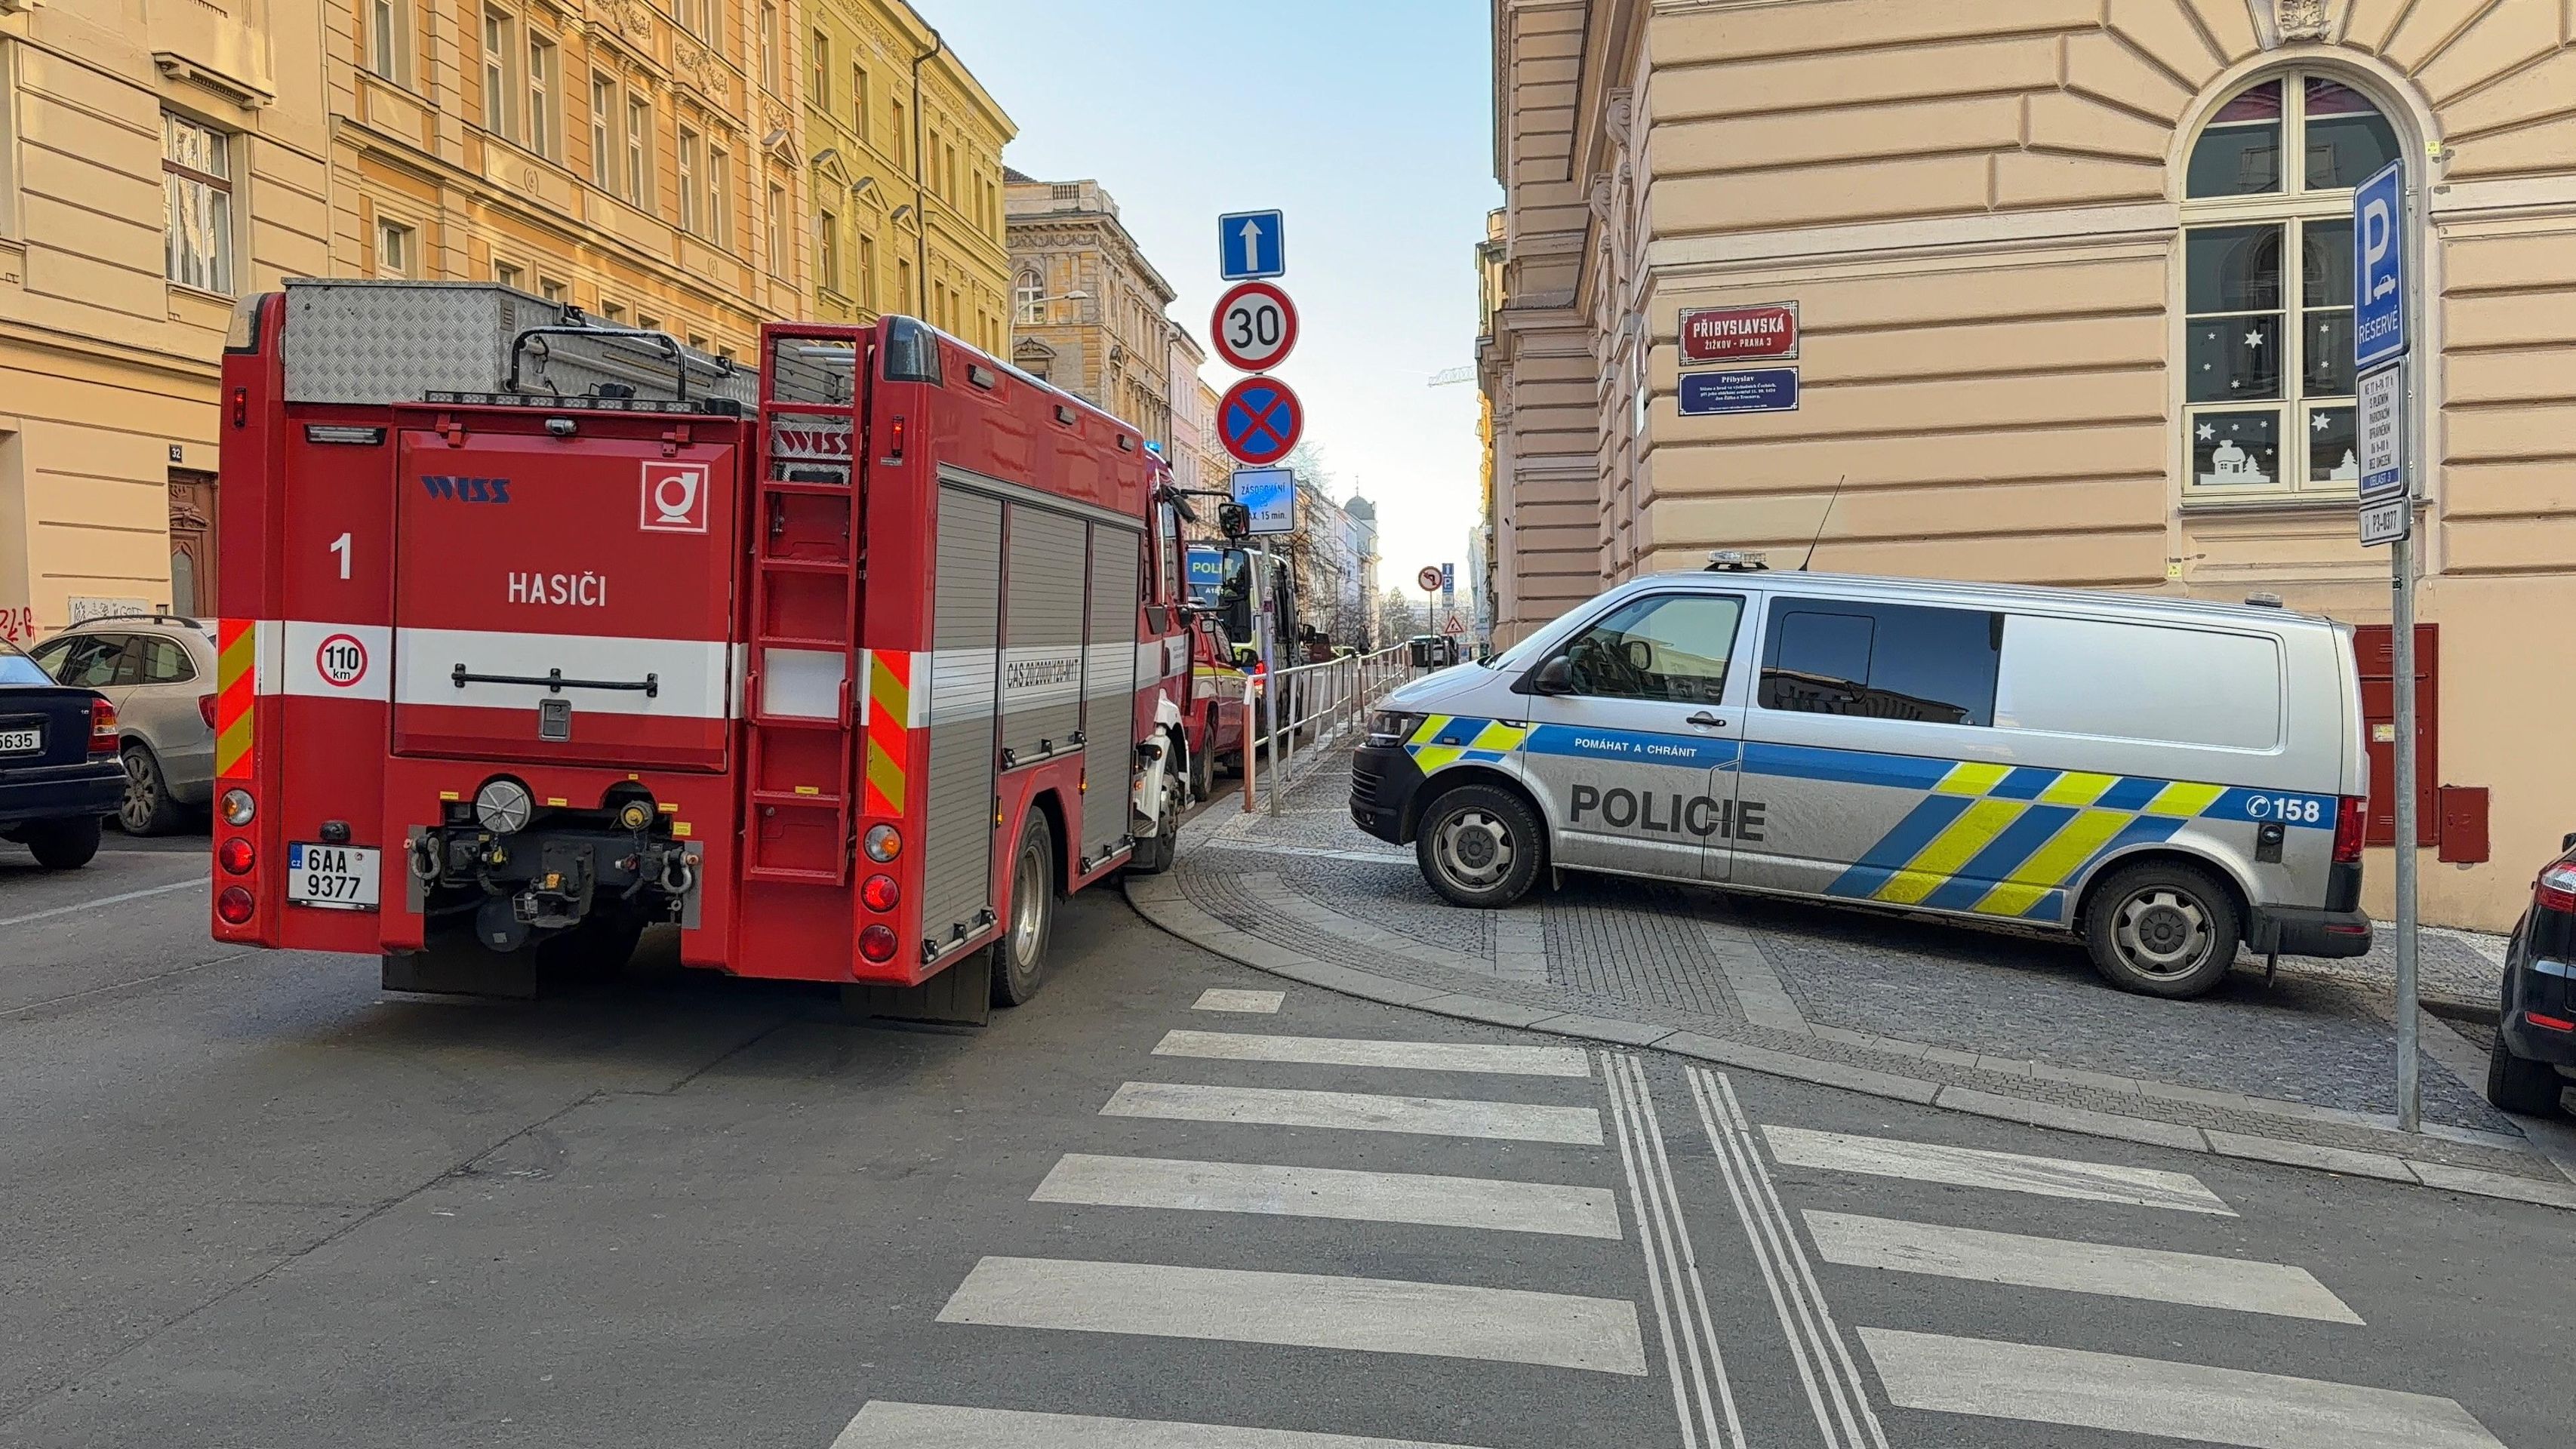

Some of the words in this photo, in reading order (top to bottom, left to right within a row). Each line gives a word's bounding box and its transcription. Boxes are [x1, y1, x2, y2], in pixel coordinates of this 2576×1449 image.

[2364, 198, 2390, 306] P
[1230, 305, 1279, 348] 30
[1693, 313, 1784, 337] PŘIBYSLAVSKÁ
[2359, 305, 2399, 344] RÉSERVÉ
[1705, 340, 1731, 350] ŽIŽKOV
[1740, 337, 1764, 347] PRAHA
[1767, 337, 1771, 346] 3
[172, 448, 181, 459] 32
[777, 430, 853, 454] WISS
[419, 475, 511, 503] WISS
[1261, 511, 1270, 520] 15
[1271, 510, 1287, 520] min.
[2373, 509, 2397, 534] P3-0377
[331, 533, 351, 580] 1
[1192, 562, 1223, 574] POLI
[508, 571, 605, 607] HASIČI
[1444, 578, 1451, 588] P
[325, 646, 359, 670] 110
[333, 669, 350, 680] km
[1008, 663, 1023, 688] CAS
[1575, 738, 1629, 752] POMÁHAT
[1633, 743, 1642, 753] A
[1647, 745, 1697, 758] CHRÁNIT
[1570, 784, 1766, 841] POLICIE
[2273, 798, 2319, 823] 158
[309, 849, 347, 873] 6AA
[308, 874, 361, 899] 9377
